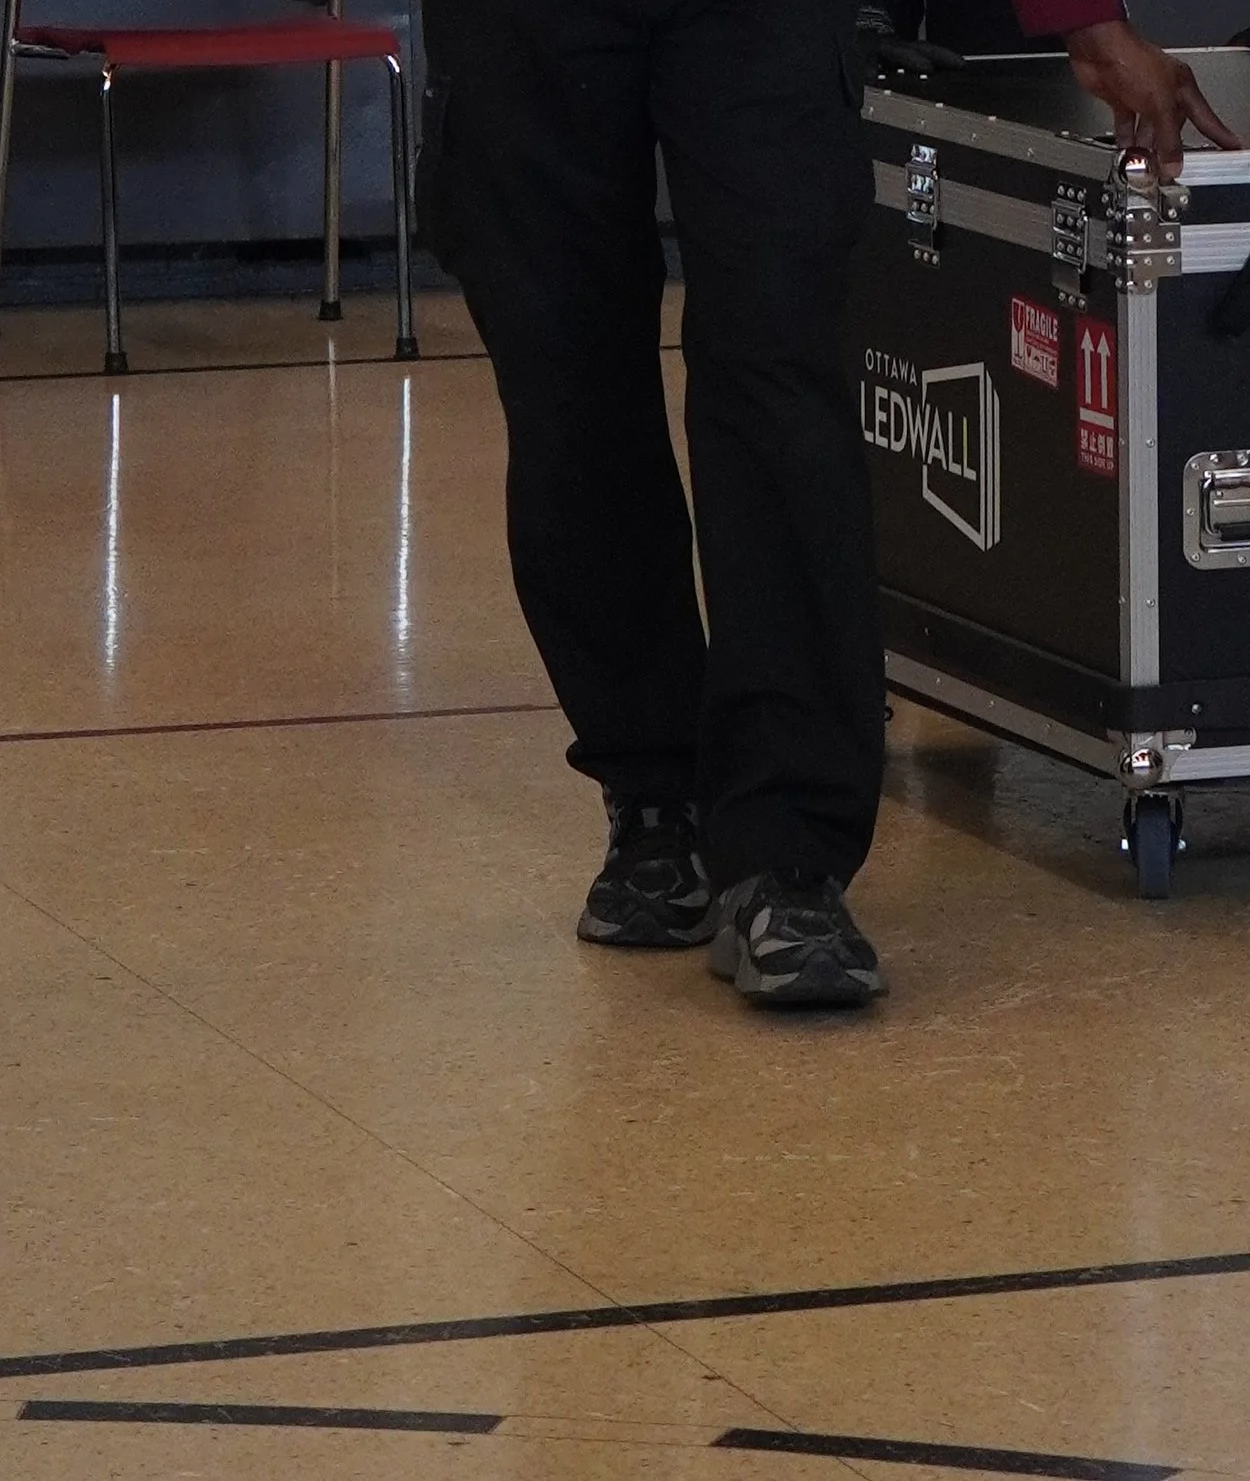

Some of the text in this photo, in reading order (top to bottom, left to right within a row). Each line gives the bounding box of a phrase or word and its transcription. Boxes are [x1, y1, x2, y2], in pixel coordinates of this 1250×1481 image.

[1025, 304, 1058, 342] FRAGILE
[865, 348, 918, 387] OTTAWA
[860, 380, 977, 481] LEDWALL
